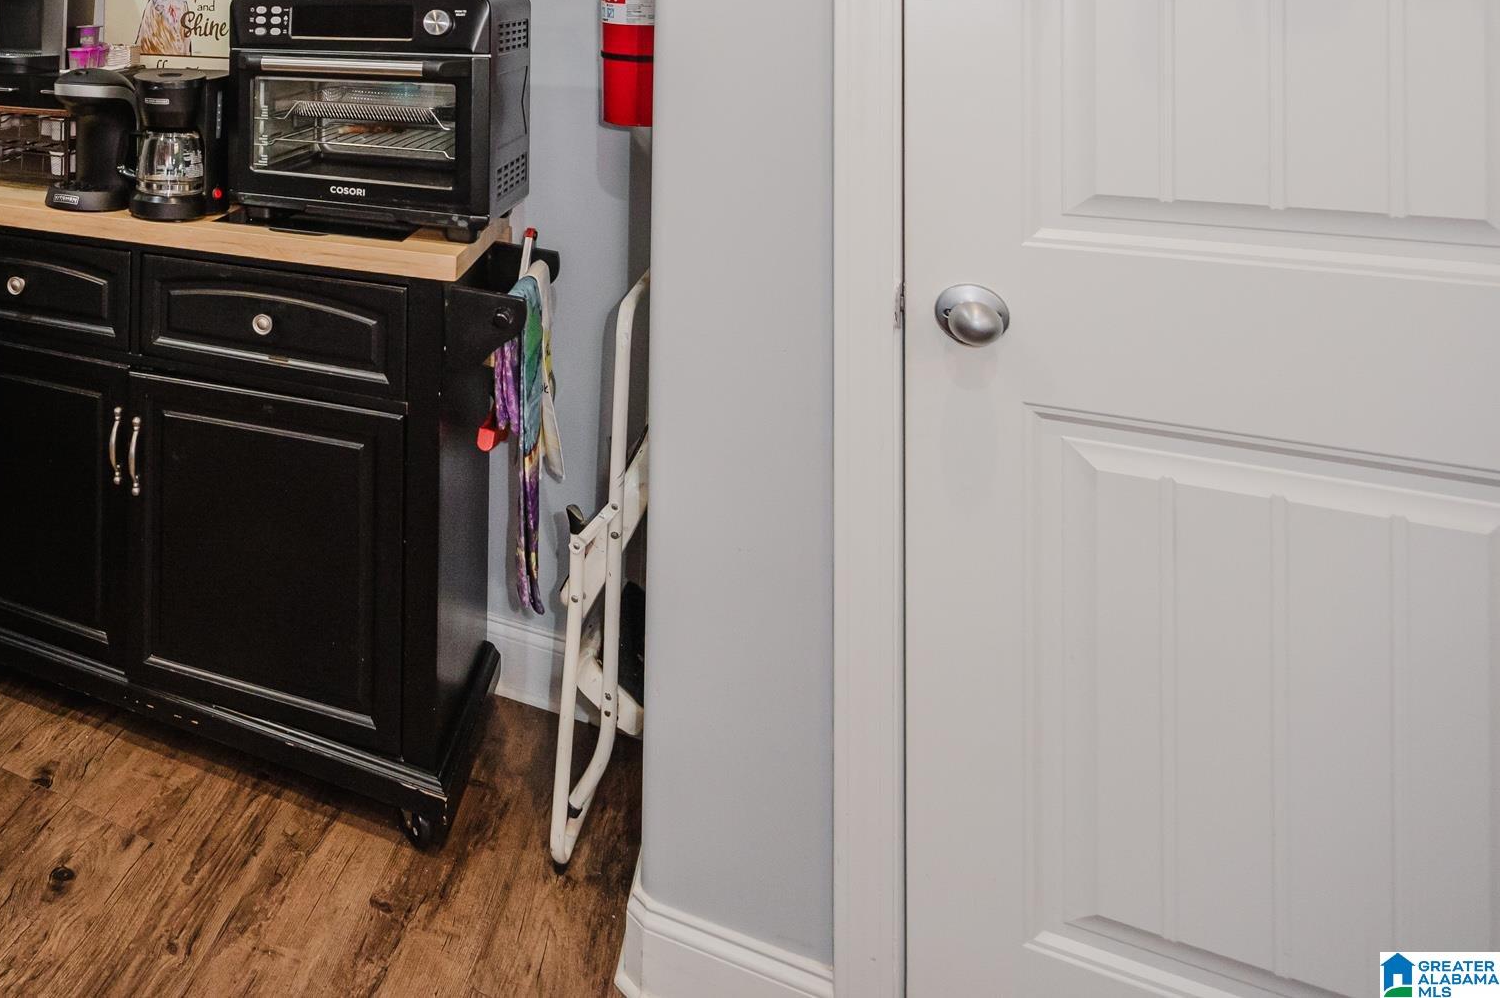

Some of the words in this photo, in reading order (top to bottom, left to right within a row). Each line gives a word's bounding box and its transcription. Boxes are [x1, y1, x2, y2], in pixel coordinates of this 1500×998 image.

[197, 0, 216, 12] and
[180, 11, 229, 41] Shine
[329, 185, 366, 197] COSORI
